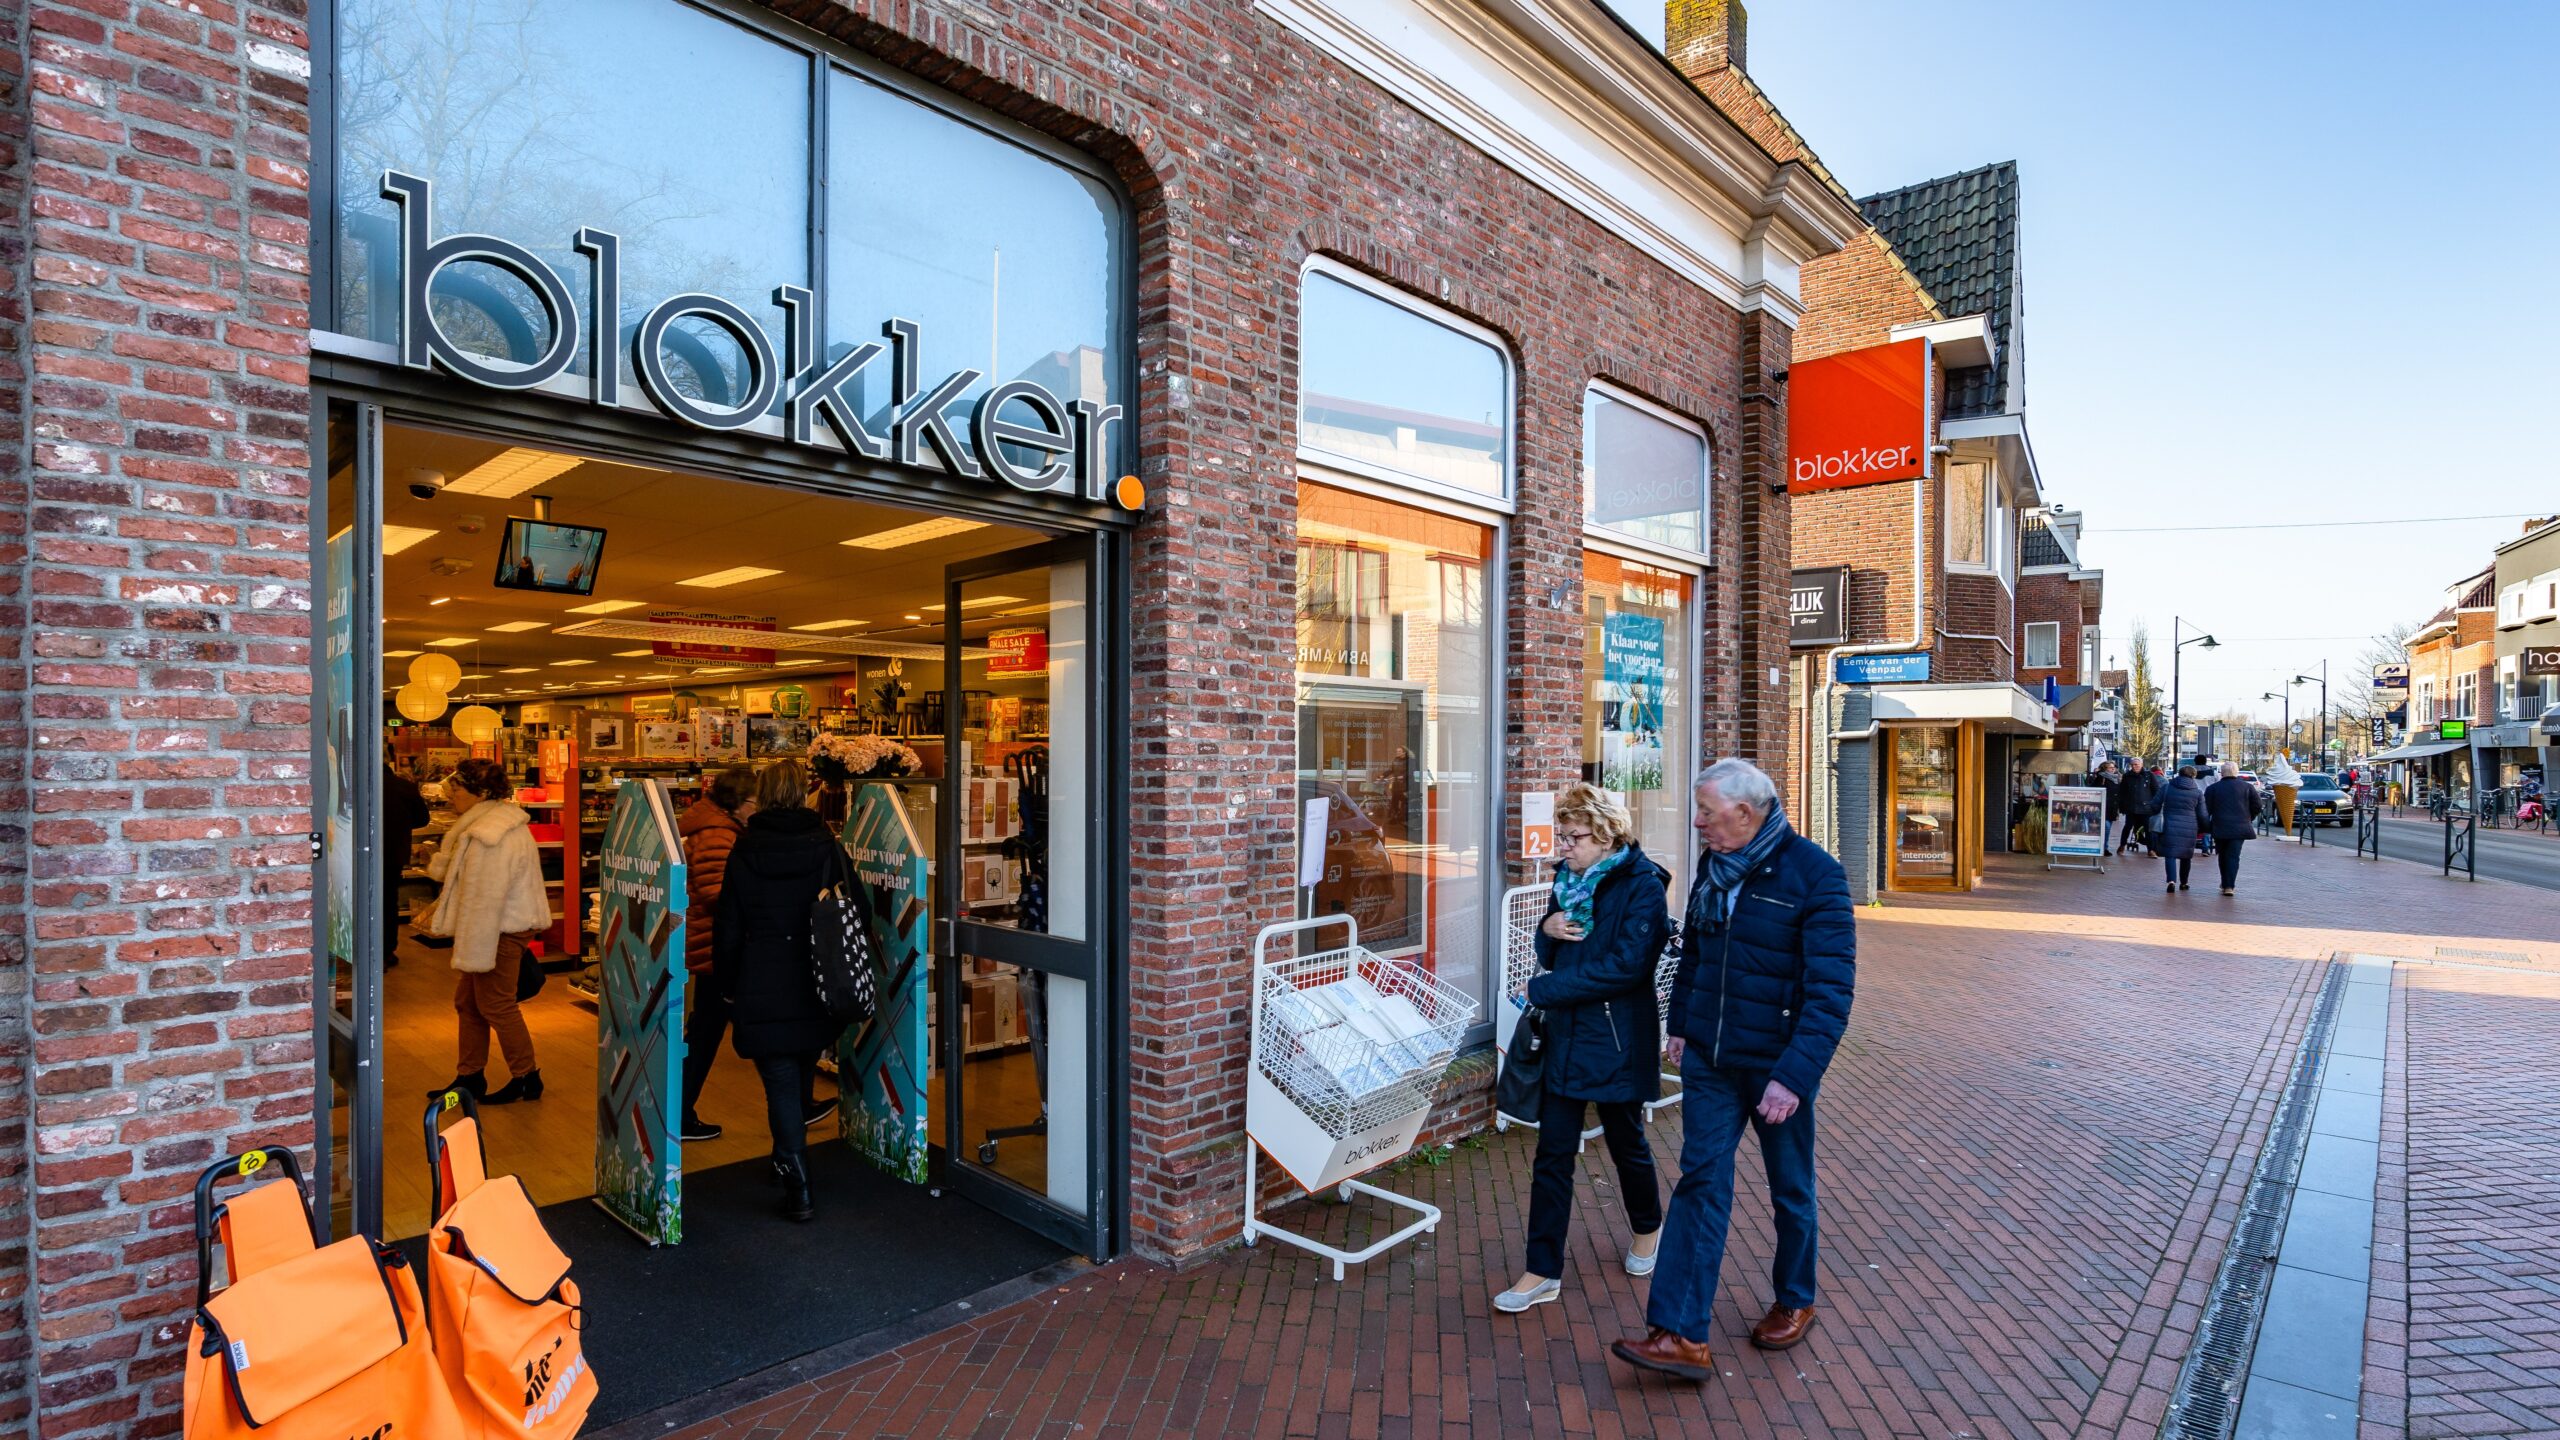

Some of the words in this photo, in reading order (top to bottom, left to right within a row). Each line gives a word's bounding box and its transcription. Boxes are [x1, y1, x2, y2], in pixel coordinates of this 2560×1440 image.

[1800, 616, 1818, 625] diner
[1010, 637, 1030, 648] SALE
[1611, 633, 1639, 649] Klaar
[1640, 640, 1659, 651] voor
[1608, 648, 1622, 664] het
[1624, 652, 1661, 670] voorjaar
[1843, 657, 1876, 666] Eemke
[1880, 657, 1899, 665] van
[1903, 656, 1921, 664] der
[866, 669, 887, 678] wonen
[1859, 664, 1903, 674] Veenpad
[605, 848, 632, 871] Klaar
[634, 857, 661, 876] voor
[879, 850, 907, 867] voor
[1902, 851, 1947, 859] internoord
[860, 868, 910, 892] voorjaar
[603, 871, 615, 894] het
[616, 877, 664, 905] voorjaar
